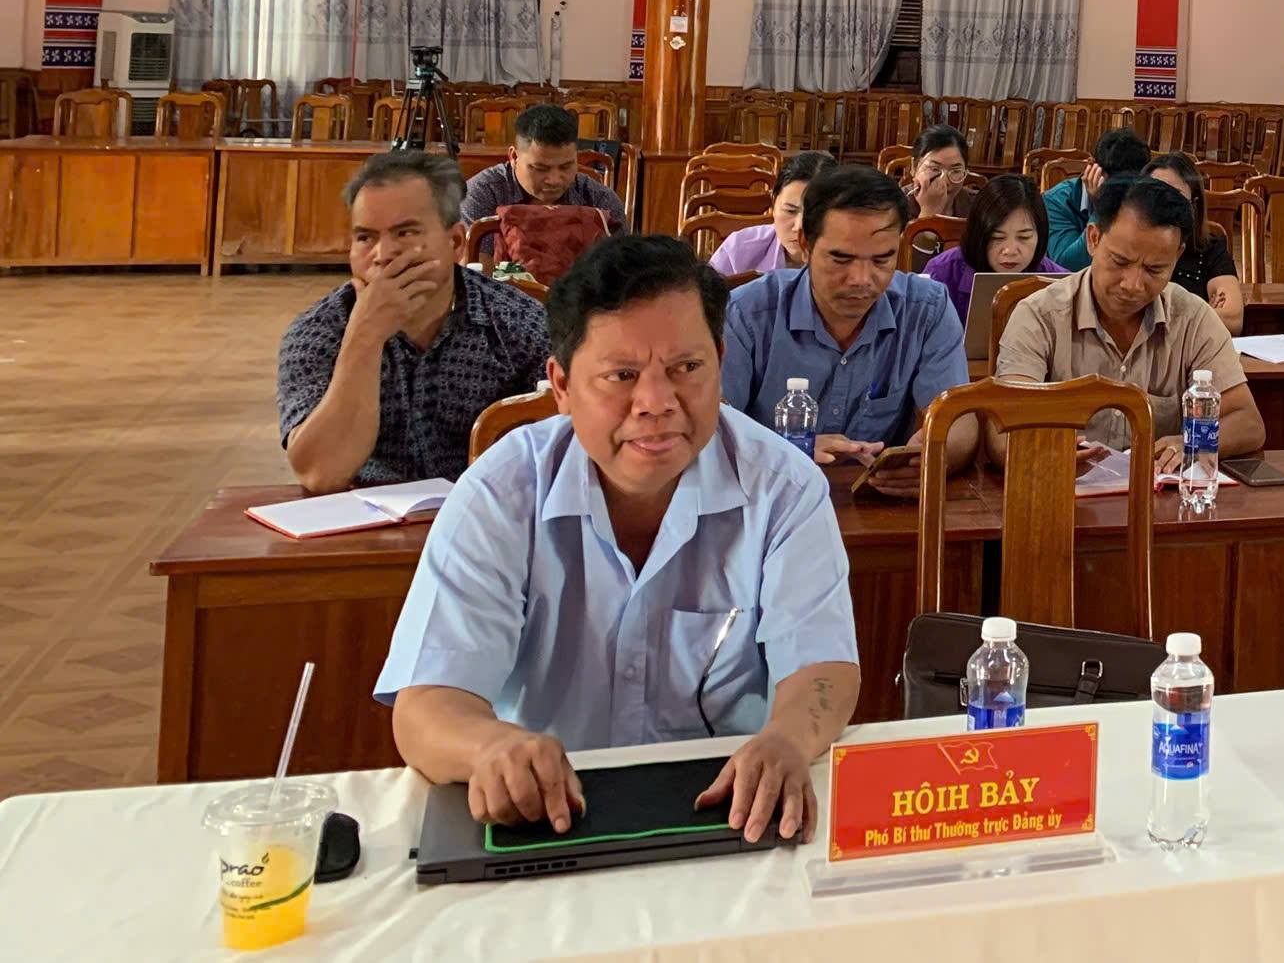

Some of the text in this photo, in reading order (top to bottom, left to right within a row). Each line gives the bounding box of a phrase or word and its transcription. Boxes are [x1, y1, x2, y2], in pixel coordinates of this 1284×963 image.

[1158, 741, 1201, 756] AQUAFINA
[891, 769, 1040, 817] HÔIH BẢY
[865, 828, 889, 847] Phó
[893, 825, 907, 845] Bí
[910, 824, 933, 843] thư
[983, 817, 1009, 836] trực
